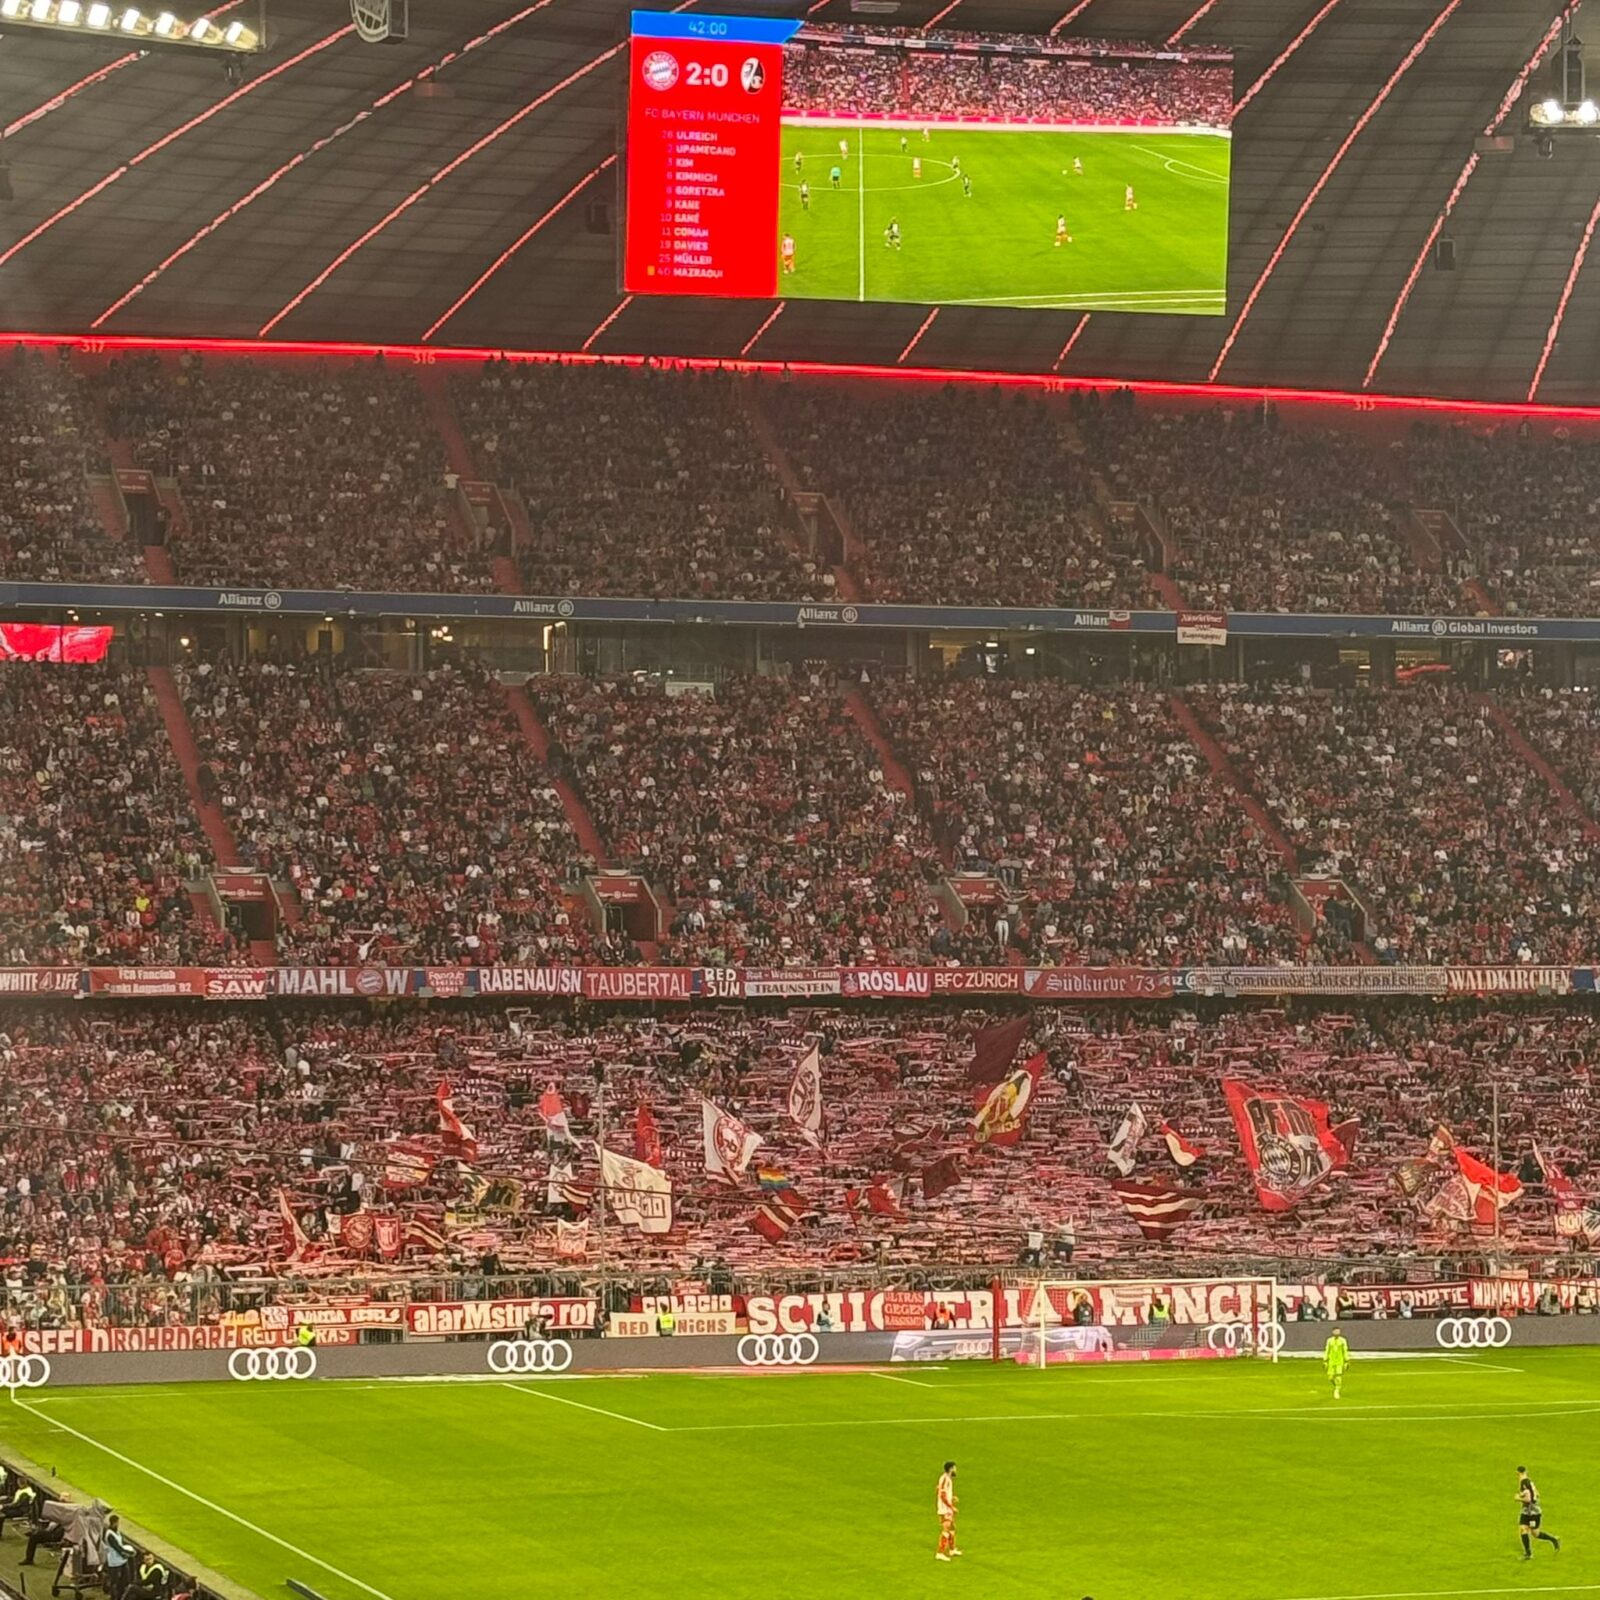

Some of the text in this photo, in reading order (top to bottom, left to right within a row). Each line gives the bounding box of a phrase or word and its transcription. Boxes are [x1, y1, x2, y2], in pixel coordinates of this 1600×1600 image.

[688, 21, 728, 35] 42:00
[685, 62, 729, 87] 2:0
[645, 108, 659, 119] FC
[661, 109, 705, 122] BAYERN
[676, 131, 718, 142] ULREICH
[676, 145, 736, 156] UPAMECANO
[676, 158, 694, 168] KIM
[675, 172, 718, 183] KIMMICH
[675, 186, 725, 197] GORETZKA
[674, 200, 701, 210] KANE
[673, 227, 709, 238] COMAN
[673, 240, 708, 251] DAVIES
[673, 252, 712, 265] MÜLLER
[672, 268, 723, 279] MAZRAOUI
[218, 593, 263, 605] Allianz
[513, 601, 556, 613] Allianz
[797, 607, 839, 620] Allianz
[1391, 621, 1538, 635] Allianz Global Investors
[0, 972, 38, 991] WHITE
[54, 972, 79, 991] LIFE
[278, 969, 354, 994] MAHL
[384, 969, 409, 994] W
[705, 969, 736, 981] RED
[858, 970, 928, 993] RÖSLAU
[965, 970, 1018, 989] ZÜRICH
[1449, 969, 1570, 990] WALDKIRCHEN
[208, 980, 265, 993] SAW
[587, 972, 691, 997] TAUBERTAL
[707, 981, 740, 997] SUN
[755, 983, 834, 993] TRAUNSTEIN
[1046, 974, 1127, 993] Südkurve
[884, 1303, 925, 1315] GEGEN
[618, 1321, 649, 1335] RED
[113, 1327, 237, 1352] ROHRDORF
